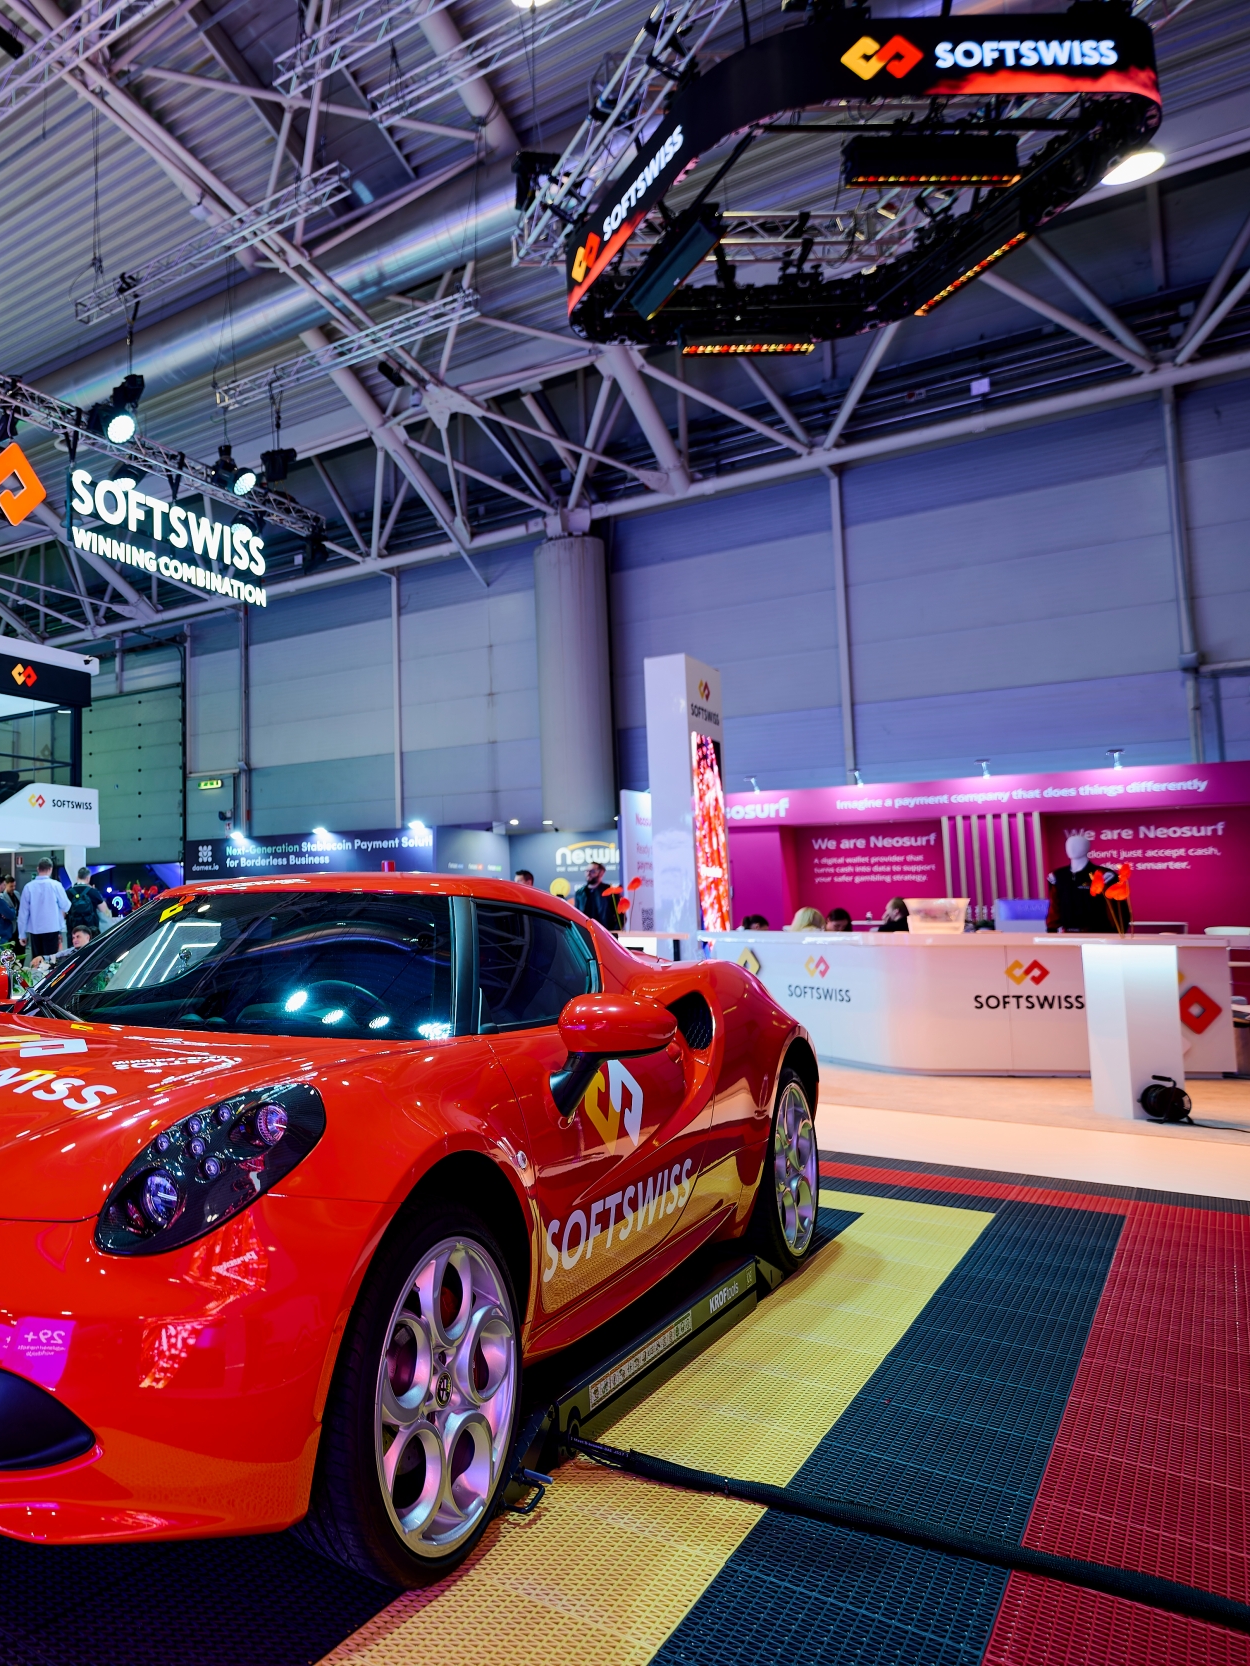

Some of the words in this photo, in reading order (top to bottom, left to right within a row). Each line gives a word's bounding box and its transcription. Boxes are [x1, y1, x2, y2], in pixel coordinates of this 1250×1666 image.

[934, 39, 1119, 69] SOFTSWISS
[602, 124, 684, 241] SOFTSWISS
[71, 468, 266, 577] SOFTSWISS
[71, 526, 157, 573] WINNING
[158, 556, 267, 608] COMBINATION
[691, 703, 720, 727] SOFTSWISS
[836, 798, 883, 811] Imagine
[884, 798, 892, 807] a
[894, 794, 949, 809] payment
[950, 791, 1010, 804] company
[1012, 788, 1041, 799] that
[1043, 786, 1077, 798] does
[1078, 783, 1124, 797] things
[1126, 778, 1209, 793] differently
[52, 799, 92, 811] SOFTSWISS
[1100, 828, 1134, 841] are
[1139, 821, 1225, 839] Neosurf
[226, 843, 299, 856] Next-Generation
[301, 840, 352, 852] Stablecoin
[354, 837, 399, 852] Payment
[812, 837, 837, 850] We
[839, 838, 867, 850] are
[869, 832, 937, 848] Neosurf
[226, 858, 239, 868] for
[240, 855, 287, 867] Borderless
[289, 854, 329, 865] Business
[870, 854, 905, 864] provider
[1119, 848, 1143, 861] just
[1144, 847, 1186, 859] accept
[903, 864, 936, 873] support
[788, 984, 851, 1003] SOFTSWISS
[974, 994, 1085, 1010] SOFTSWISS
[543, 1158, 693, 1283] SOFTSWISS
